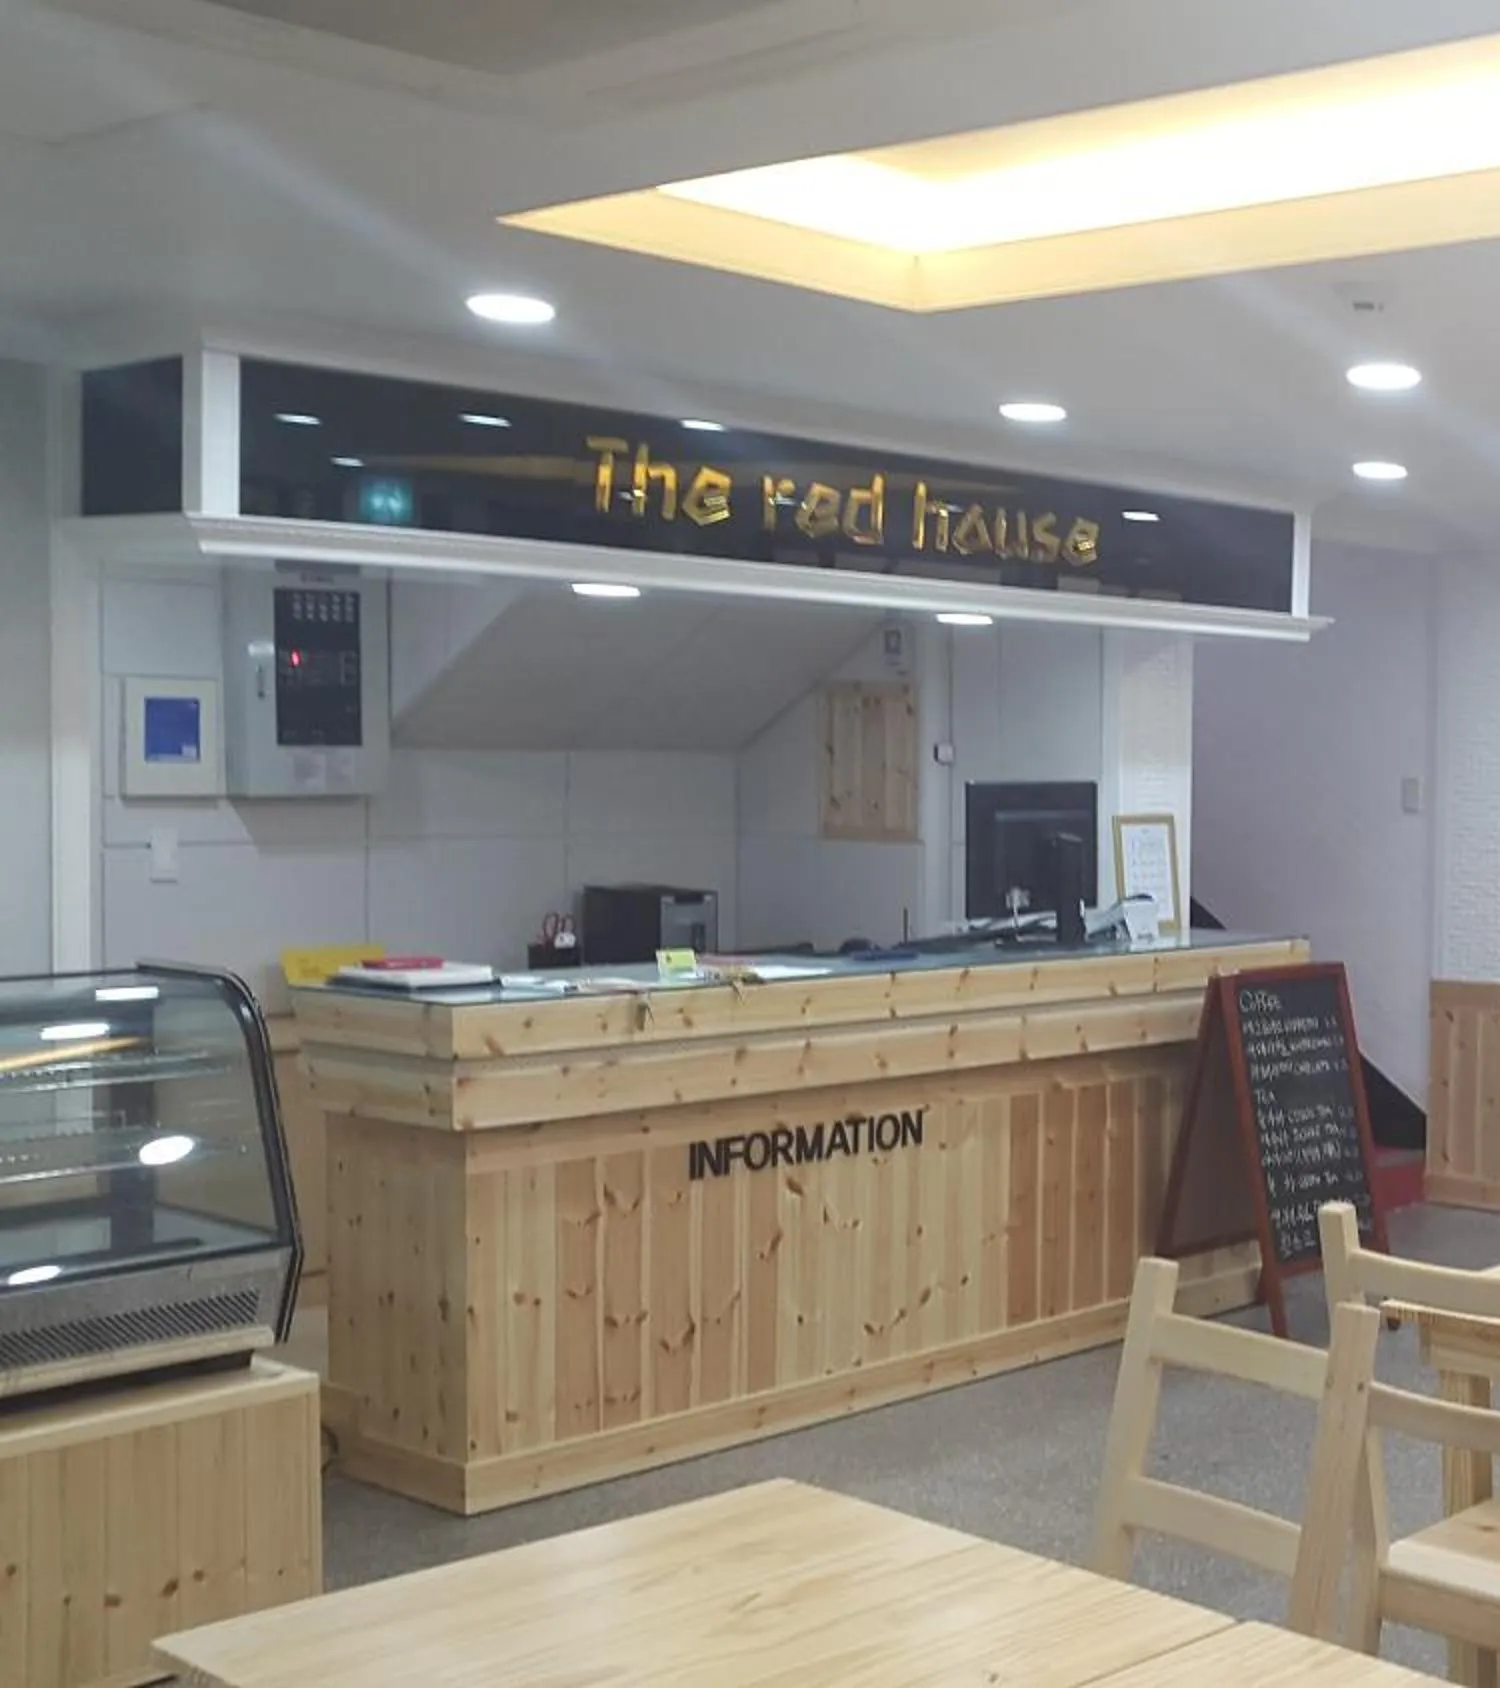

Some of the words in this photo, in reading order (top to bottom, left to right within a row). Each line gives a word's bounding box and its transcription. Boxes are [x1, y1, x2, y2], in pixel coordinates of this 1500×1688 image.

[586, 436, 732, 526] The
[762, 473, 885, 546] red
[689, 1110, 922, 1180] INFORMATION
